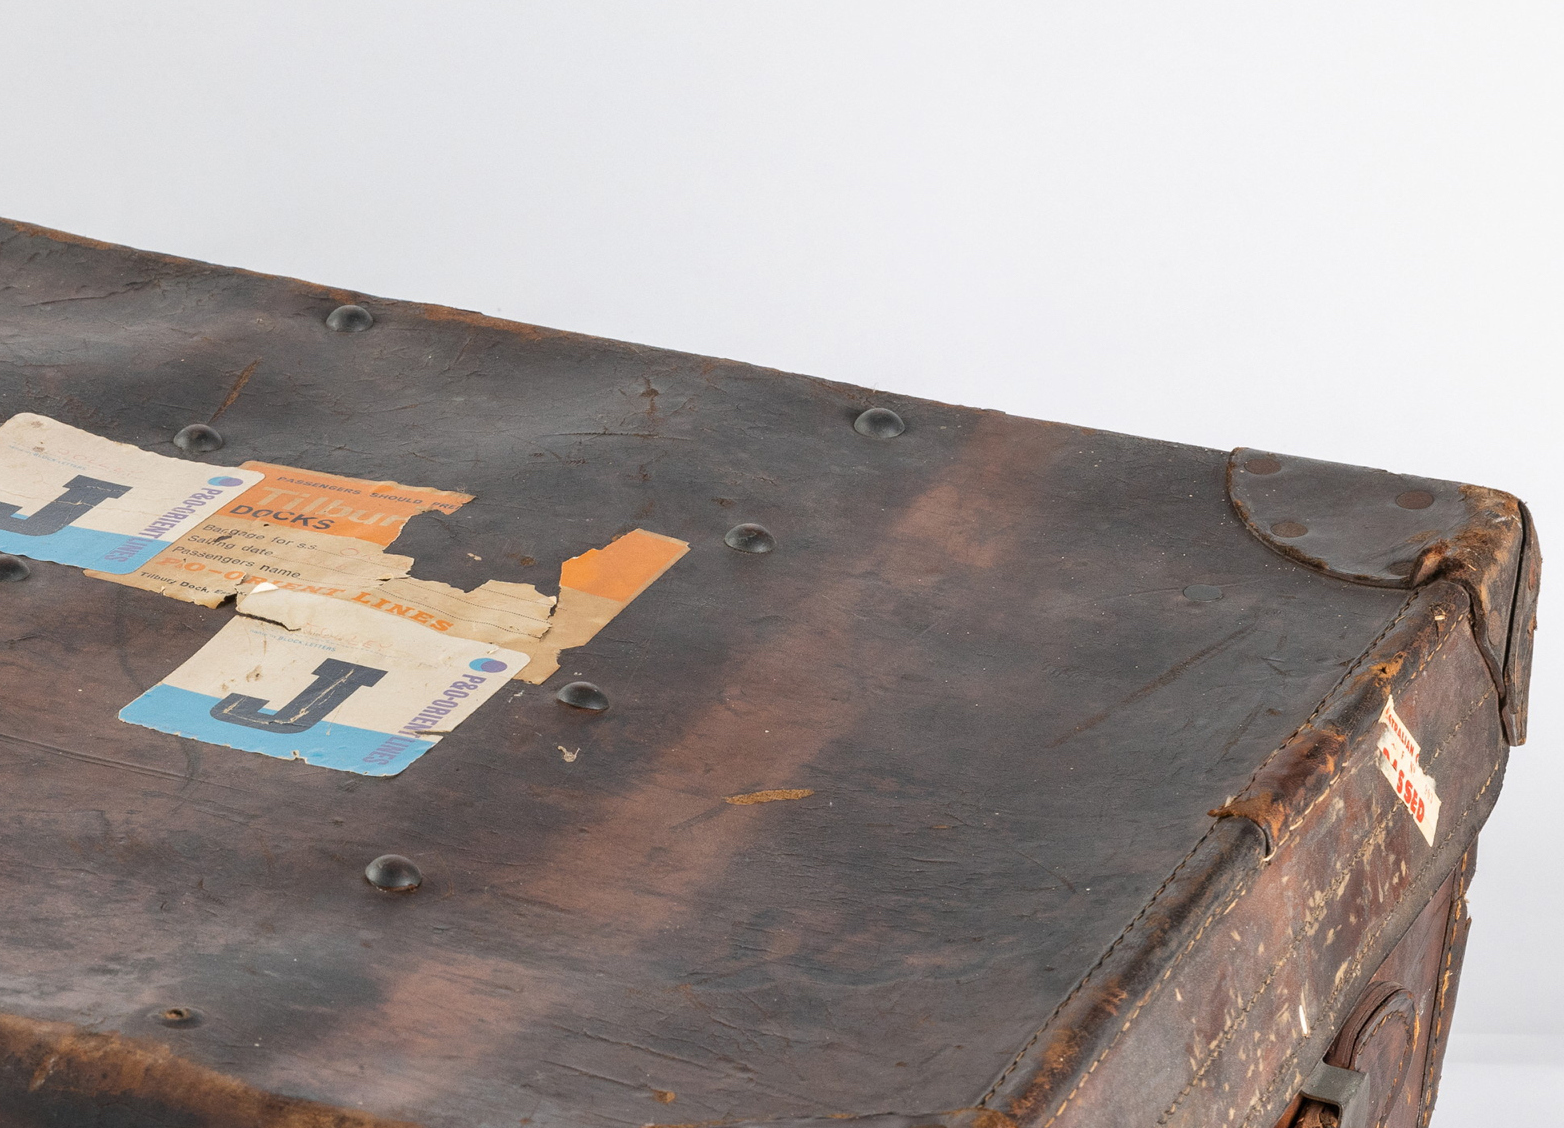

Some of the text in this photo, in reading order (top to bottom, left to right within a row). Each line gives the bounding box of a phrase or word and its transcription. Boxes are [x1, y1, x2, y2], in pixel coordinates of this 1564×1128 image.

[276, 476, 362, 495] PASSENGERS
[369, 492, 423, 506] SHOULD
[229, 504, 336, 531] DOCKS
[256, 486, 410, 527] Tilbur
[104, 537, 154, 562] LINES
[187, 534, 274, 556] Sailing date
[271, 536, 294, 547] for
[172, 545, 255, 568] Passengers
[259, 564, 301, 578] name
[140, 571, 177, 585] Tilbury
[351, 591, 455, 632] LINES
[277, 635, 303, 645] BLOCK
[304, 640, 337, 652] LETTERS
[209, 657, 389, 734] J
[362, 674, 487, 765] P&O-ORIENT LINES
